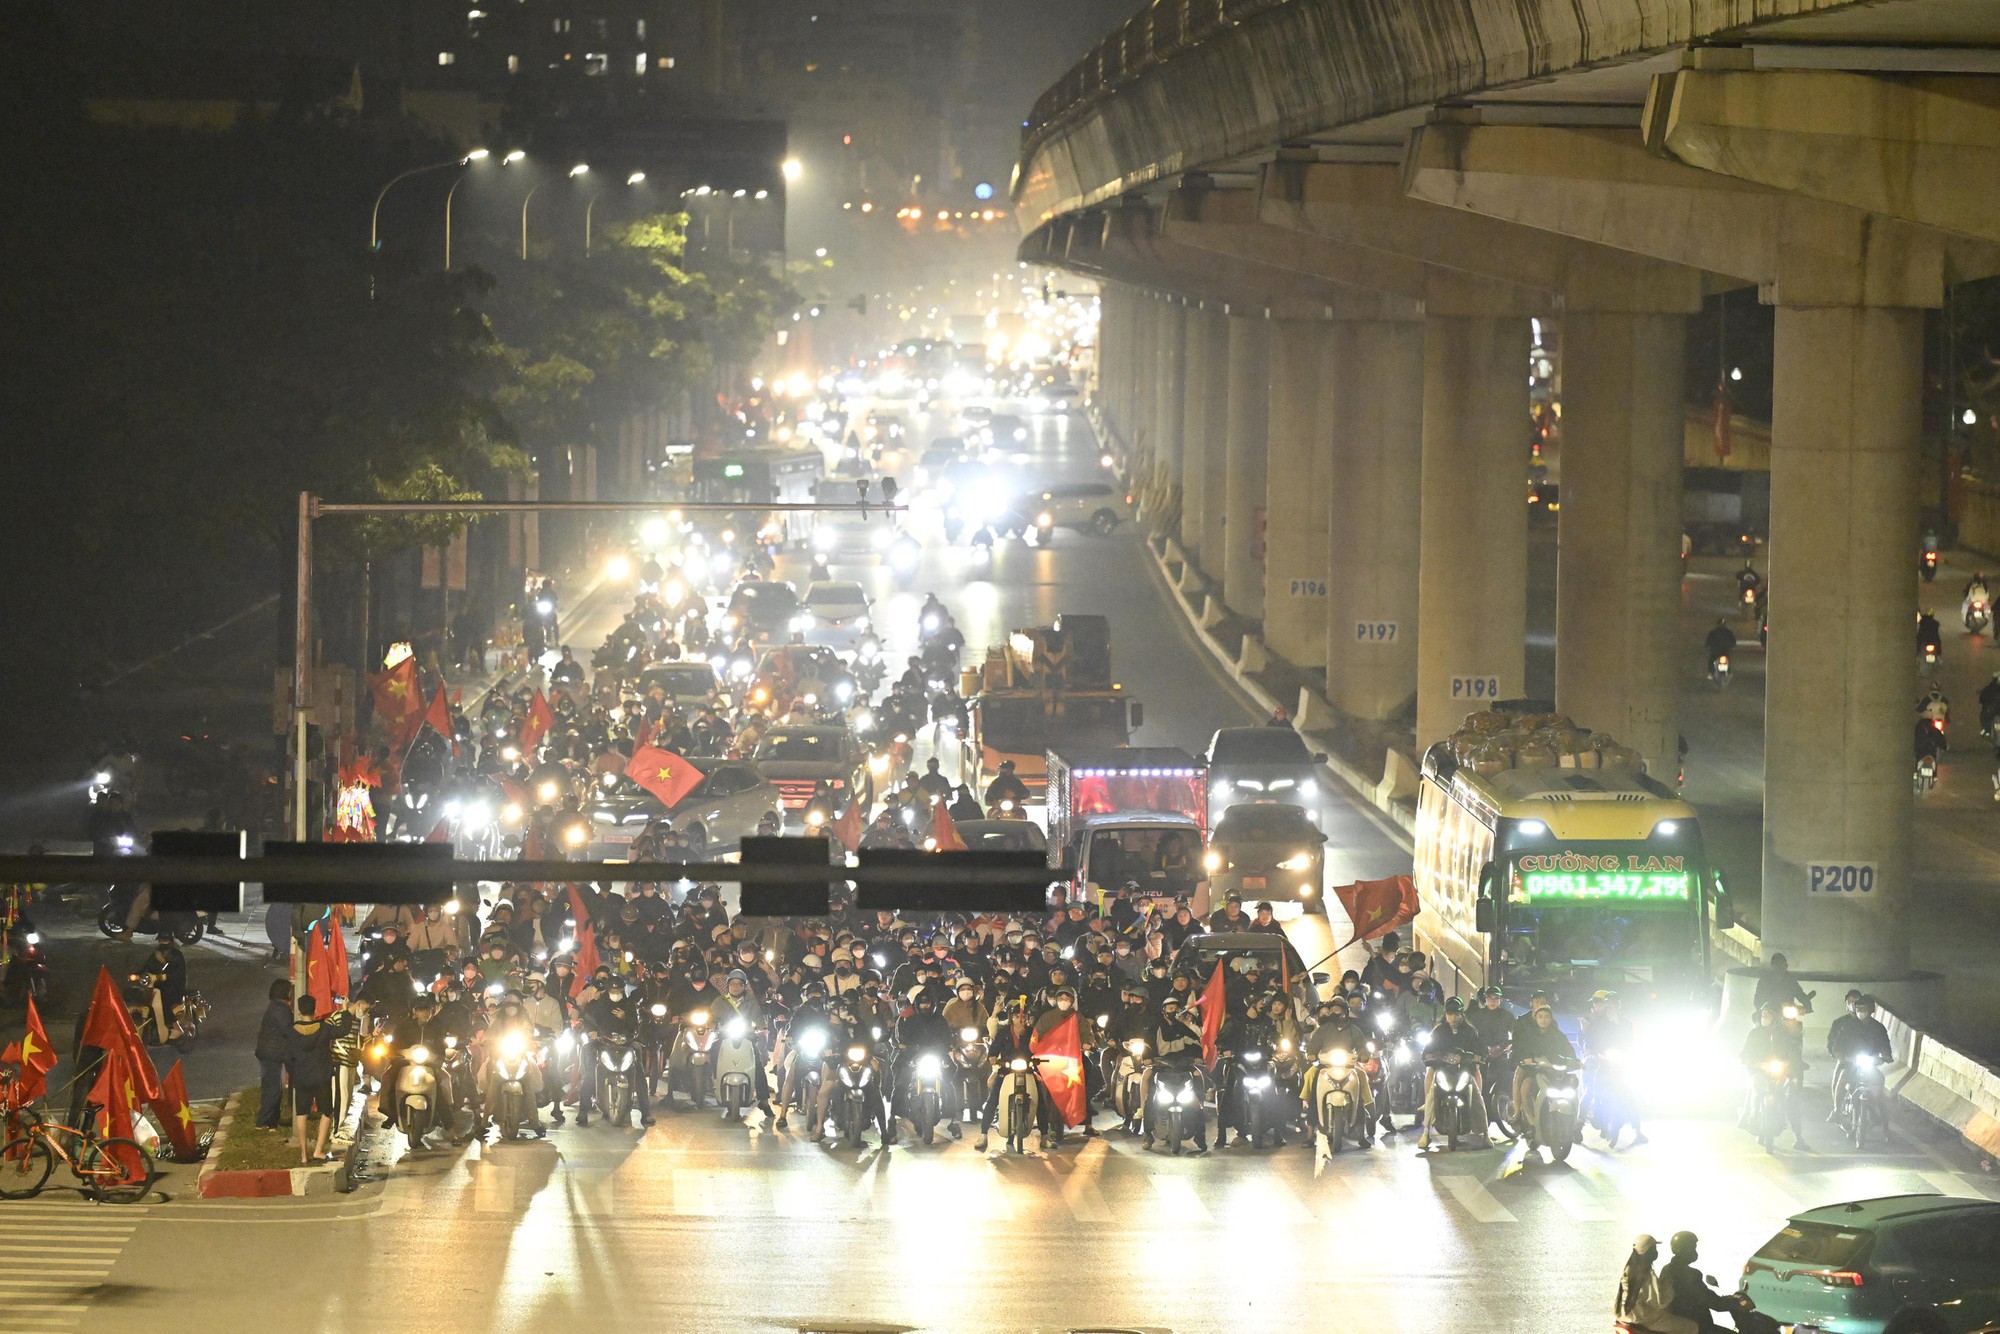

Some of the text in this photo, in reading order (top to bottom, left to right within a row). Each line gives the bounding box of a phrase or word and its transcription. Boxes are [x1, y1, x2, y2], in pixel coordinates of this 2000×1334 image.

[1291, 581, 1326, 596] P196
[1357, 624, 1397, 640] P197
[1452, 678, 1497, 697] P198
[1519, 850, 1684, 872] CƯỜNG LAN
[1811, 865, 1873, 892] P200
